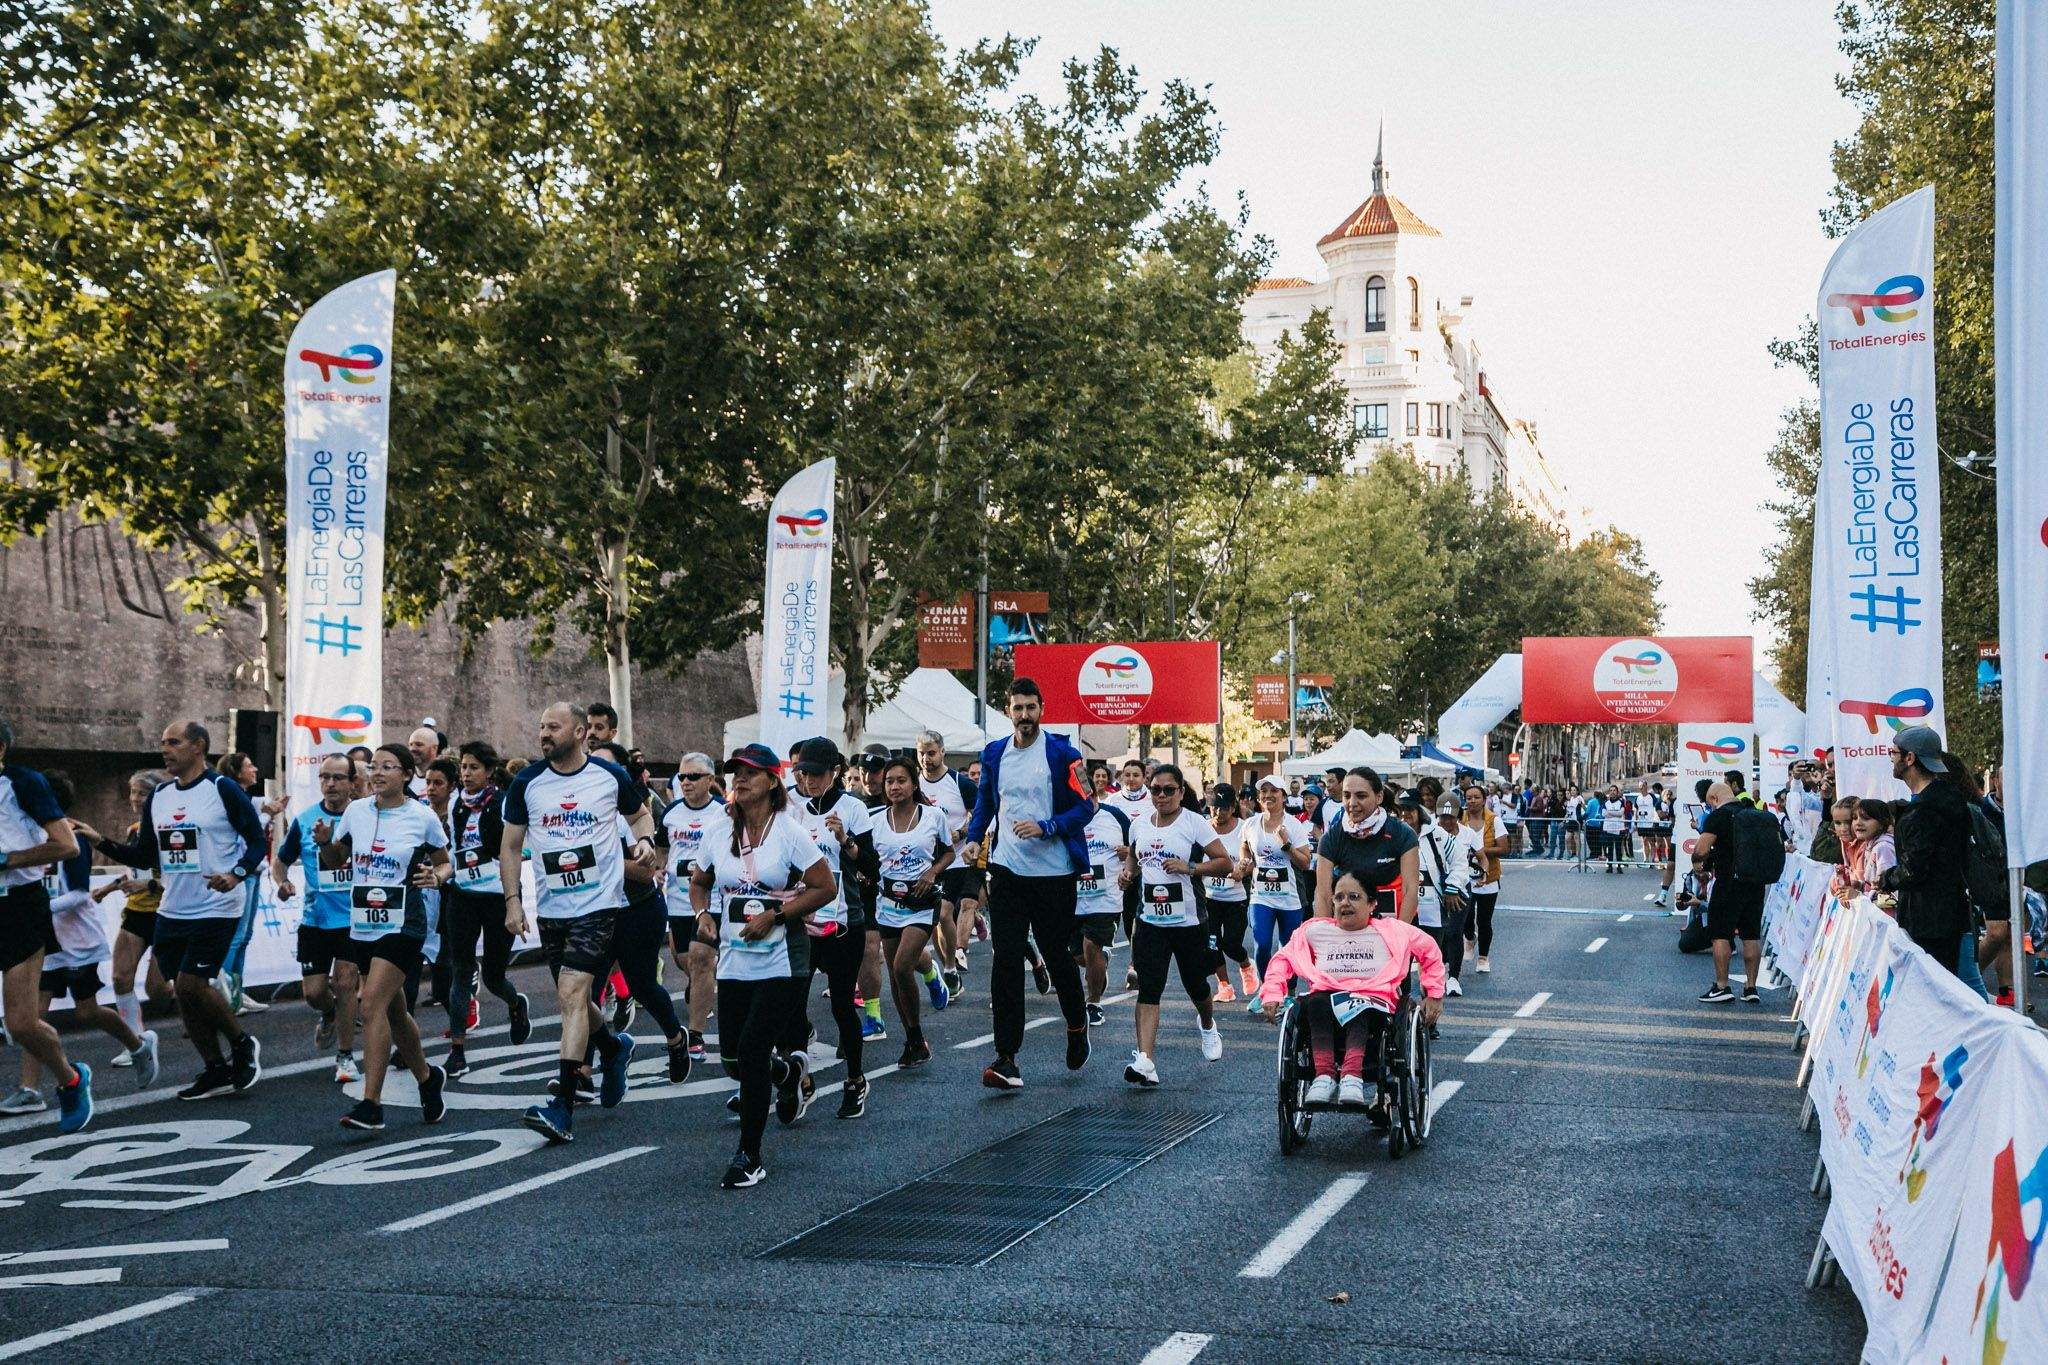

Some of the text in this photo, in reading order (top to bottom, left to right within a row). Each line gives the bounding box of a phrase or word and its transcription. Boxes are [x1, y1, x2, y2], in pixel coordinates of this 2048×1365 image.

[1828, 329, 1926, 351] TotalEnergies
[299, 390, 382, 404] TotalEnergies
[1884, 397, 1920, 577] LasCarreras
[337, 450, 368, 606] LasCarreras
[776, 542, 828, 550] TotalEnergies
[925, 604, 968, 615] ERNÁN
[994, 601, 1019, 611] ISLA
[923, 615, 968, 625] GÓMEZ
[797, 579, 818, 686] LasCarreras
[1095, 682, 1139, 690] TotalEnergies
[1613, 678, 1662, 686] TotalEnergies
[1615, 706, 1657, 714] DE MADRID
[169, 850, 187, 864] 313
[332, 869, 353, 883] 100
[468, 866, 482, 880] 91
[560, 870, 586, 887] 104
[1079, 879, 1098, 891] 296
[1211, 877, 1227, 887] 297
[1264, 882, 1281, 892] 328
[365, 908, 389, 923] 103
[1153, 902, 1173, 916] 130
[1335, 952, 1374, 960] ENTRENAN
